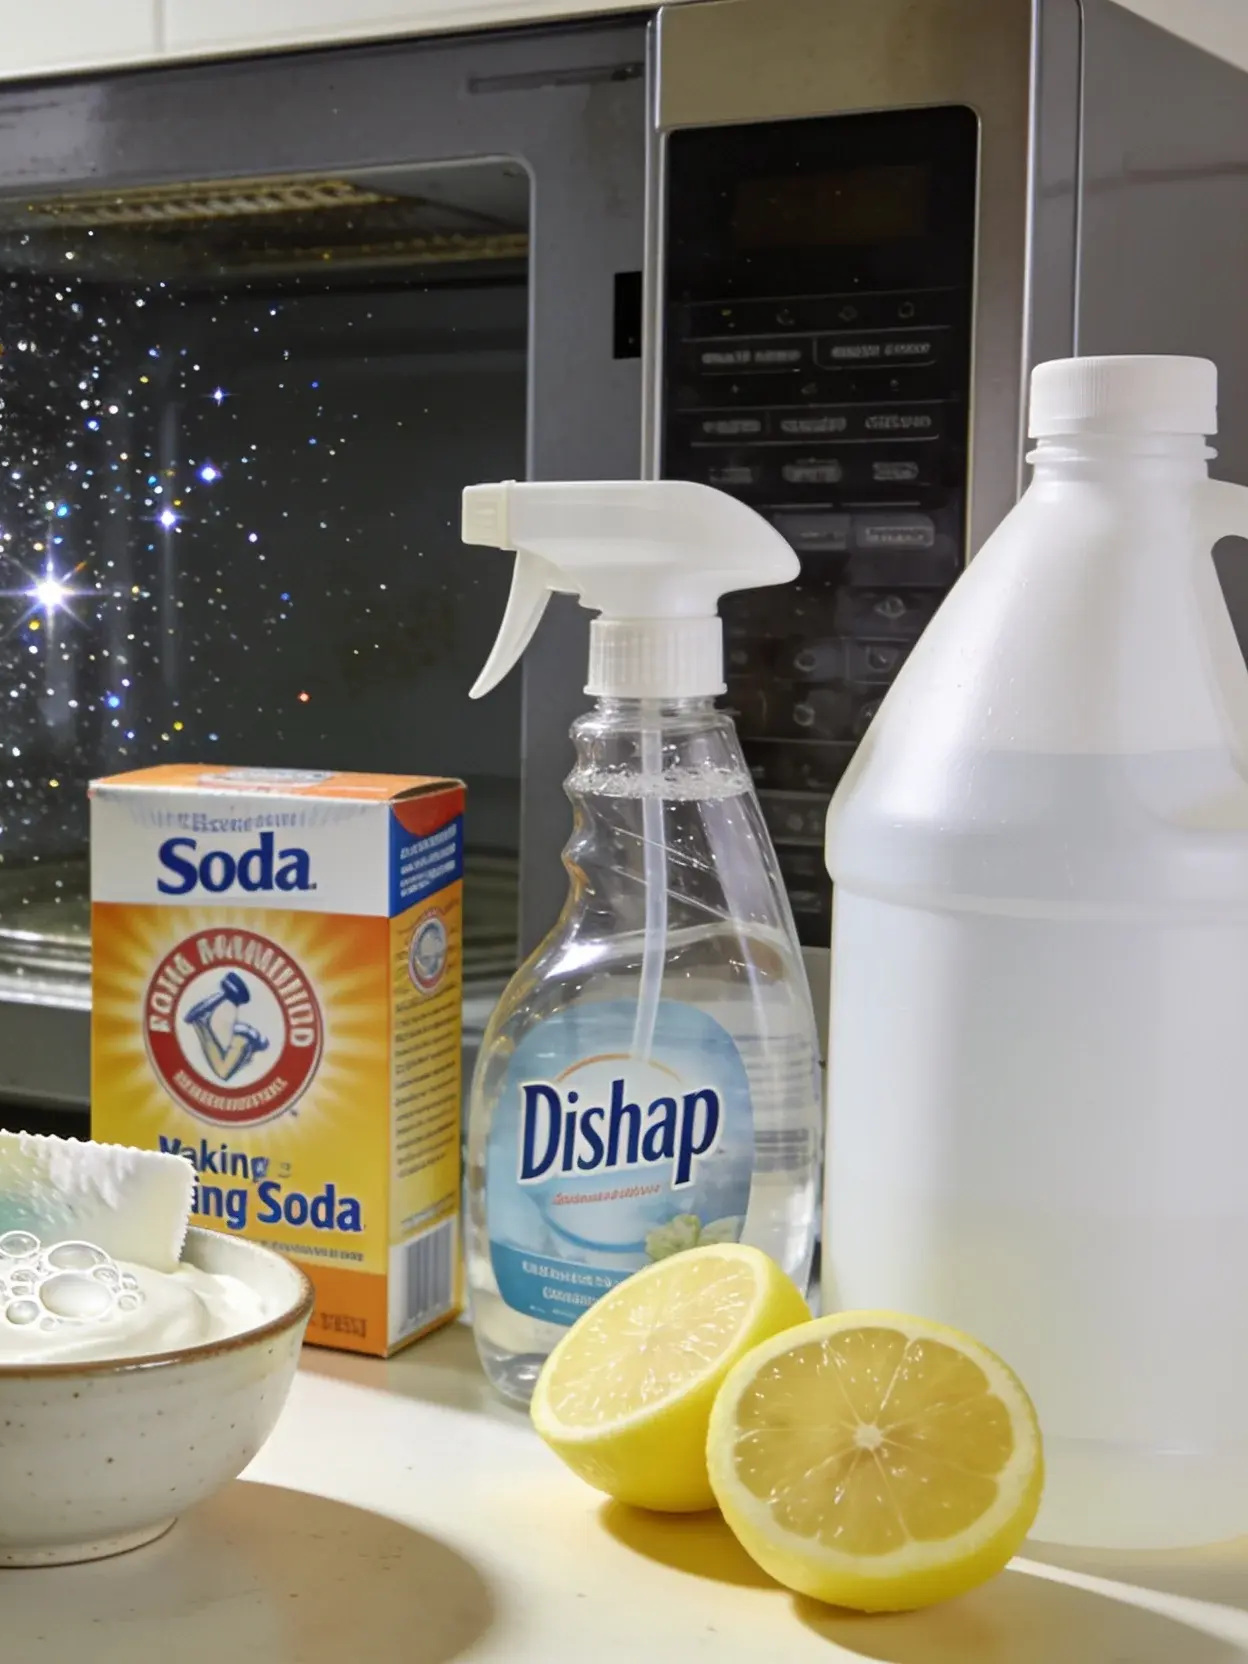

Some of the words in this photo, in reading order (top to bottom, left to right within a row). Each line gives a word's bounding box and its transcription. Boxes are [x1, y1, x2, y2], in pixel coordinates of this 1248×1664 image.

[157, 831, 312, 895] Soda
[520, 1079, 719, 1185] Dishap
[257, 1180, 363, 1232] Soda
